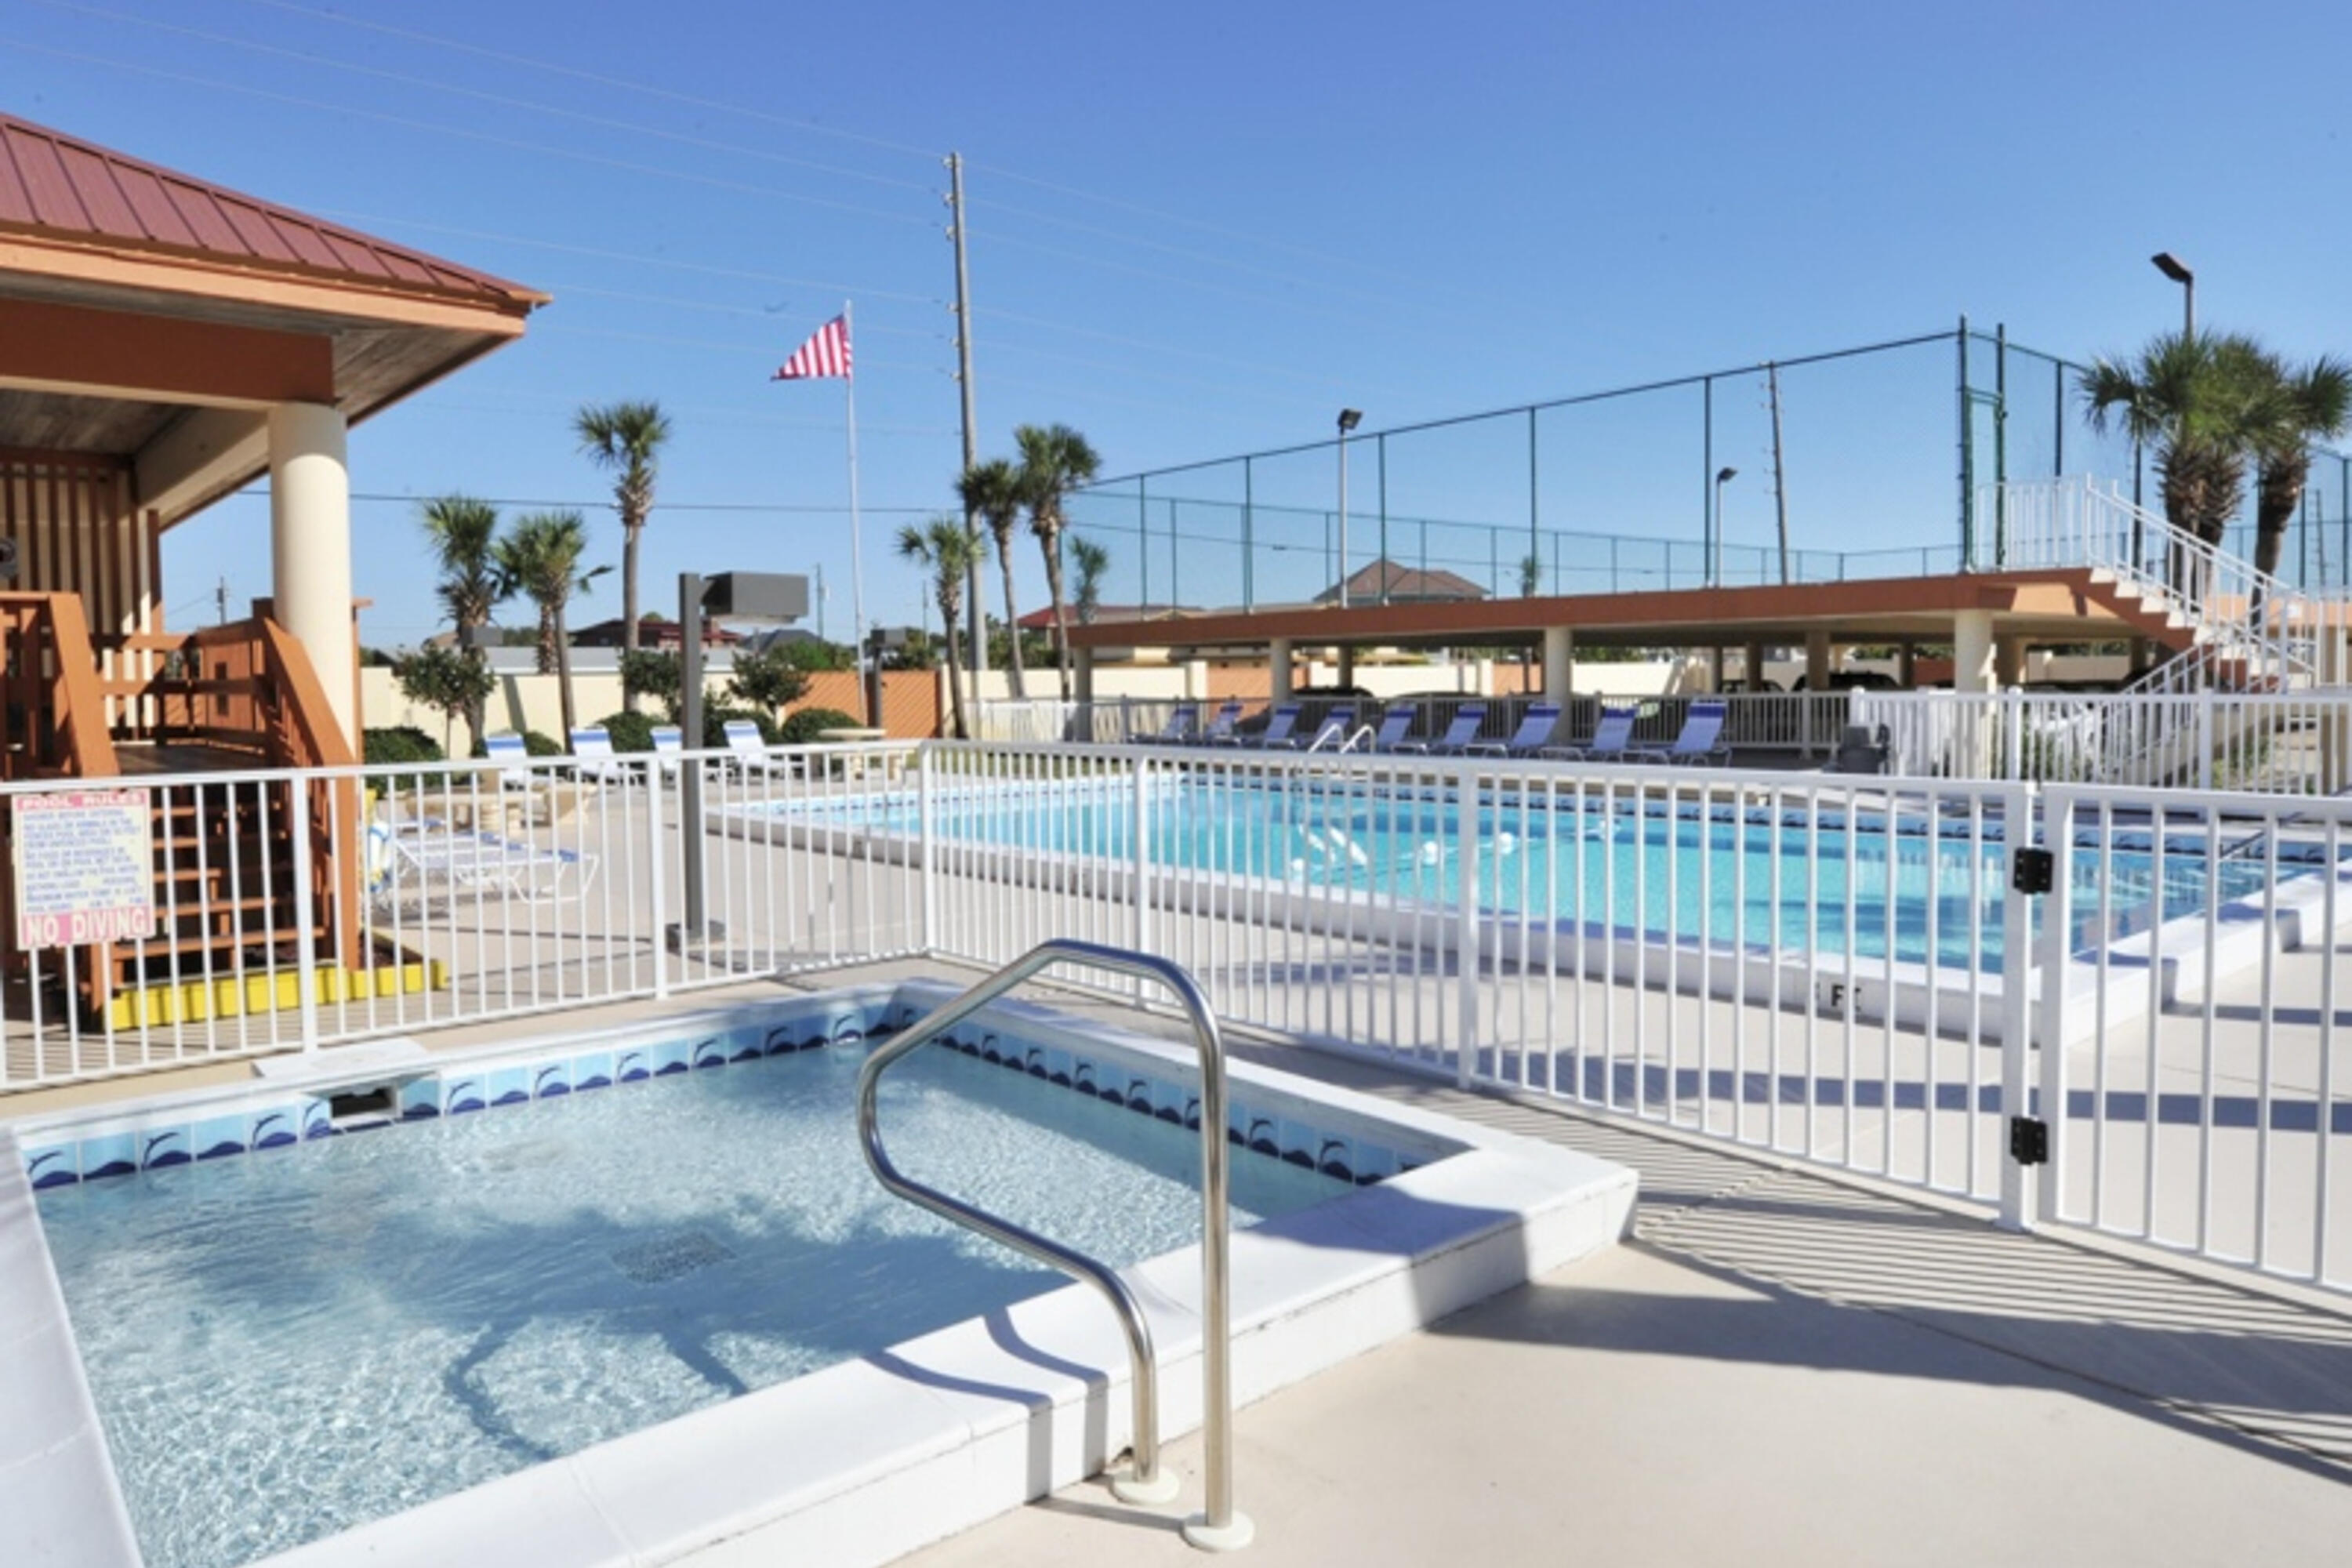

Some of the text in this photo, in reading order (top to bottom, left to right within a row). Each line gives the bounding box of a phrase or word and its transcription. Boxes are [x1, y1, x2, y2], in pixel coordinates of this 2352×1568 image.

[22, 792, 141, 808] POOL RULES
[26, 908, 146, 945] NO DIVING
